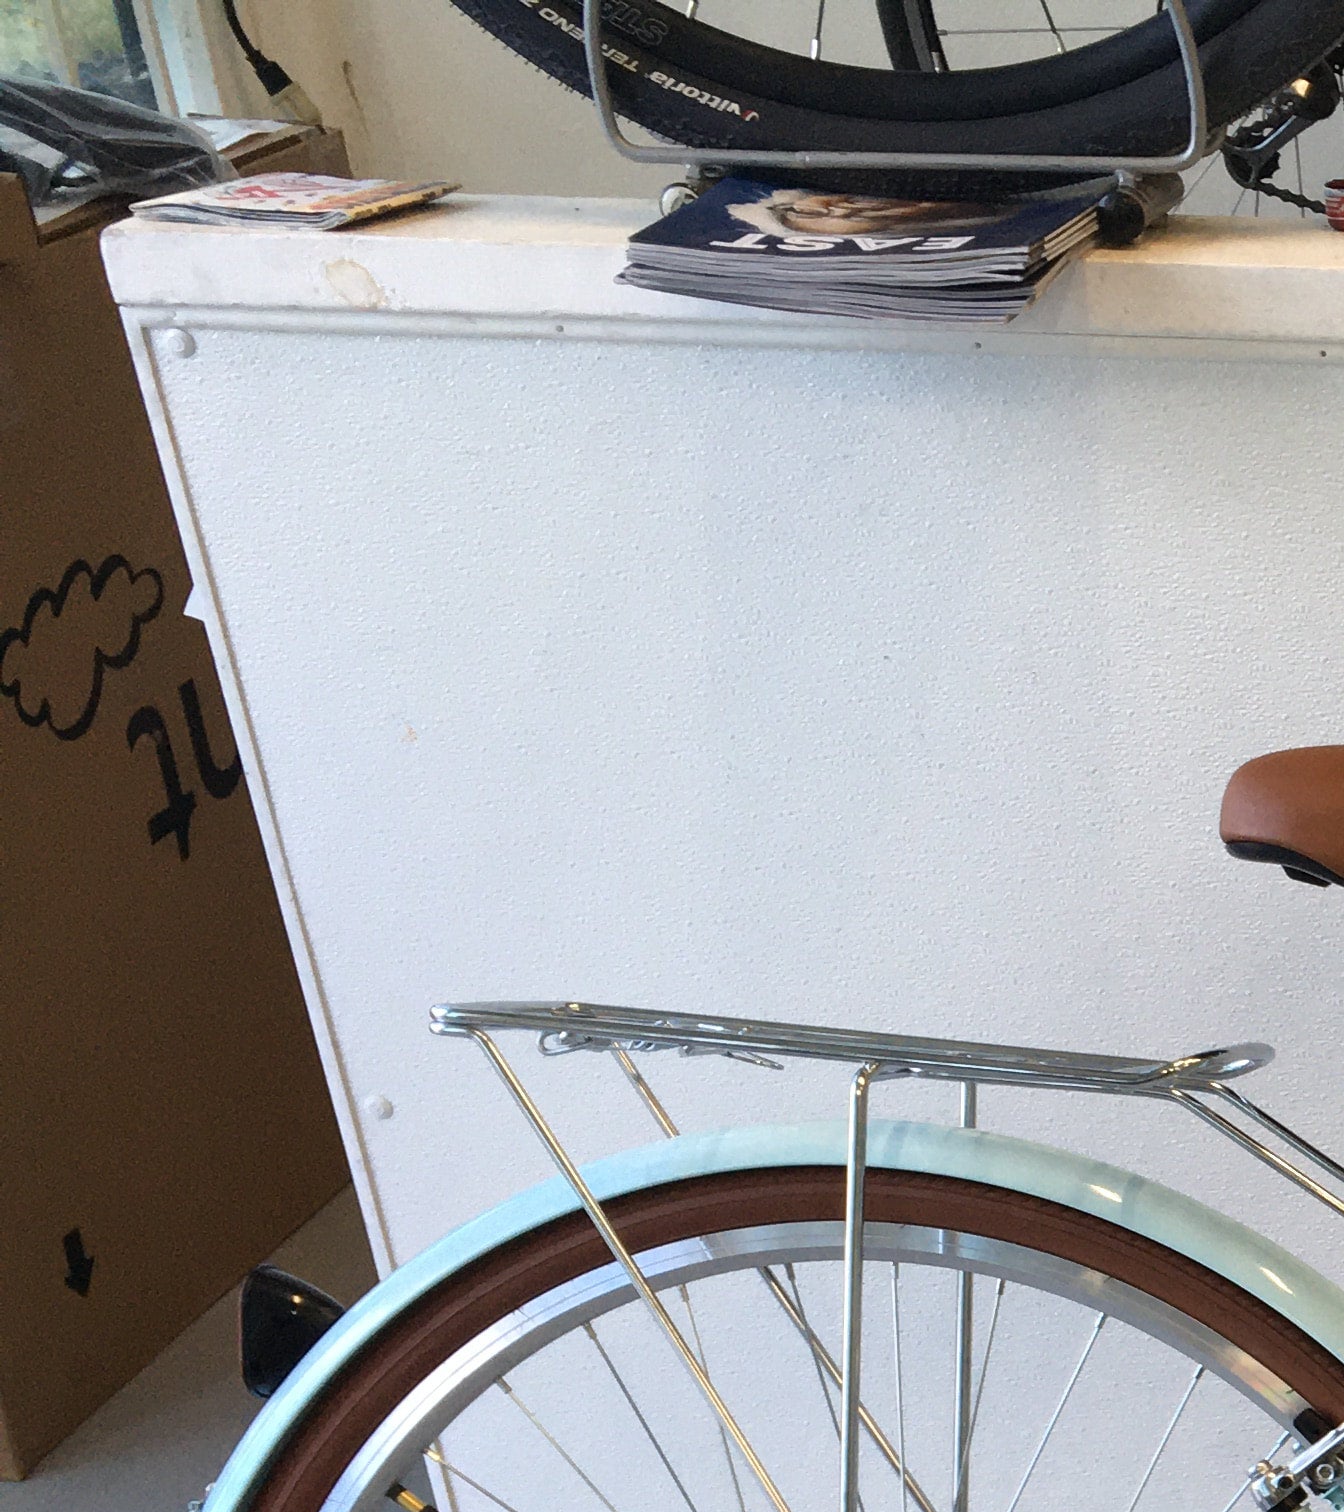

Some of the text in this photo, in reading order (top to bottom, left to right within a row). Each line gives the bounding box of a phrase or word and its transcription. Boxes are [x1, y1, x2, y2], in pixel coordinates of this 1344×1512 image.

[538, 8, 742, 115] vittoria TERENO
[708, 233, 976, 252] EAST
